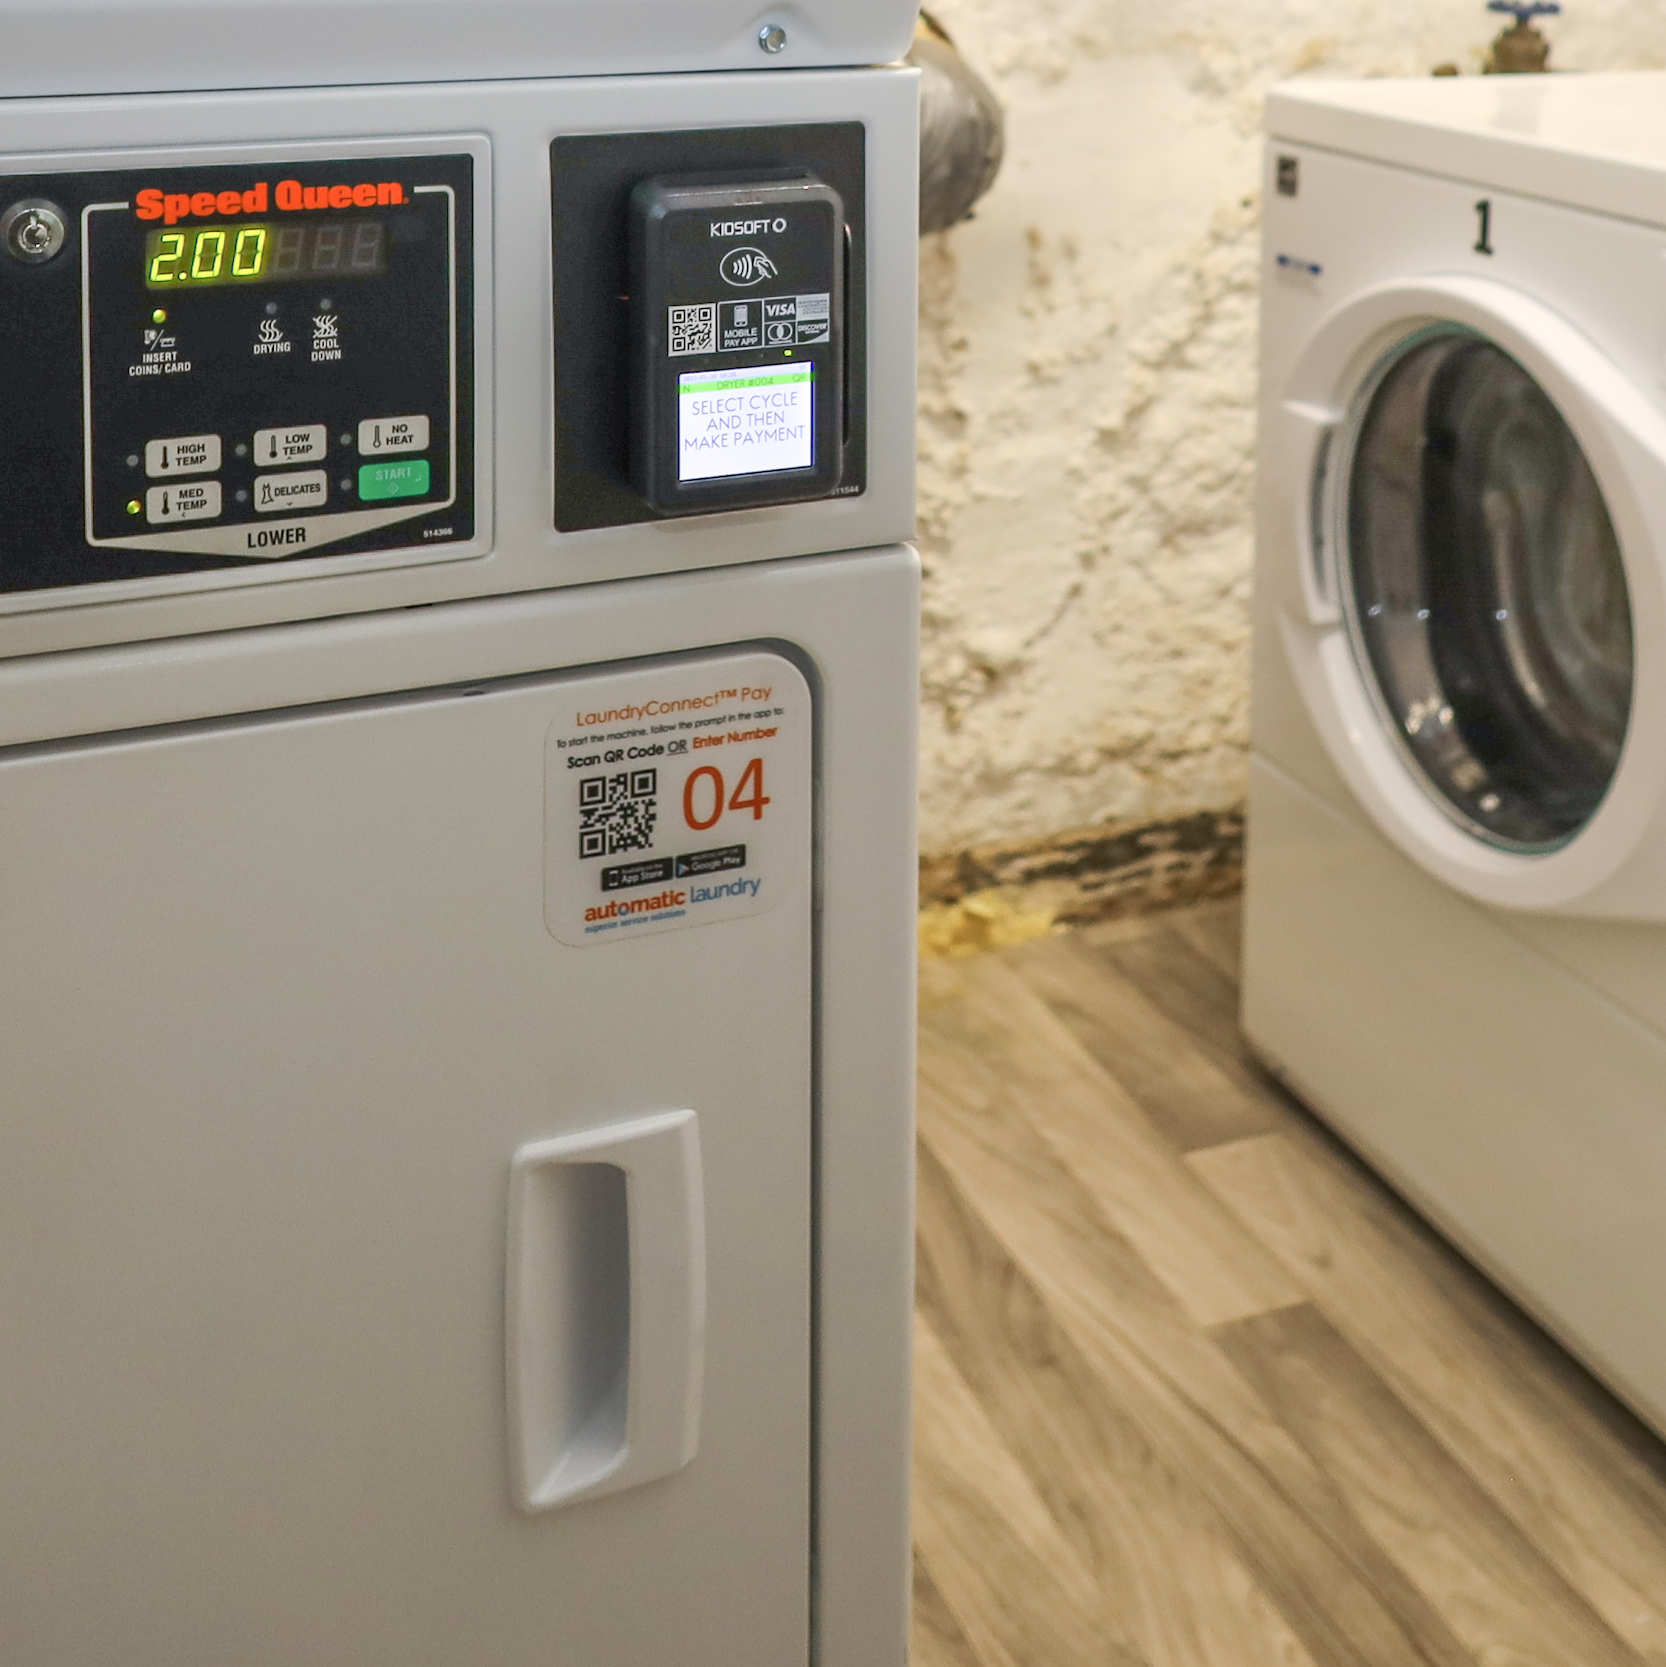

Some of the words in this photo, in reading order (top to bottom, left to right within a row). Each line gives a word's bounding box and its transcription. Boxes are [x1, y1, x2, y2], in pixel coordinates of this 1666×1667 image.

[136, 182, 268, 225] Speed
[710, 219, 771, 237] KIOSOFT
[1473, 200, 1493, 255] 1
[150, 229, 266, 282] 2.00
[765, 303, 796, 316] VISA
[724, 328, 757, 338] MOBILE
[313, 339, 339, 350] COOL
[741, 337, 757, 346] APP
[253, 342, 291, 355] DRYING
[142, 351, 178, 363] INSERT
[311, 350, 342, 362] DOWN
[165, 361, 191, 373] CARD
[717, 380, 745, 390] DRYER
[748, 377, 773, 387] #004
[792, 374, 806, 382] QR
[692, 397, 744, 416] SELECT
[749, 392, 798, 410] CYCLE
[706, 415, 741, 432] AND
[747, 411, 785, 427] THEN
[391, 424, 408, 434] NO
[285, 433, 310, 444] LOW
[385, 435, 414, 446] HEAT
[684, 433, 729, 451] MAKE
[734, 425, 805, 446] PAYMENT
[177, 443, 205, 454] HIGH
[282, 444, 313, 456] TEMP
[175, 454, 207, 466] TEMP
[375, 467, 411, 480] START
[179, 488, 204, 499] MED
[274, 483, 321, 497] DELICATES
[176, 499, 207, 511] TEMP
[247, 527, 306, 549] LOWER
[741, 686, 772, 702] Pay
[567, 753, 601, 769] Scan
[604, 749, 624, 764] QR
[627, 743, 664, 760] Code
[667, 739, 687, 755] OR
[692, 734, 725, 749] Enter
[727, 727, 778, 743] Number
[682, 757, 770, 831] 04
[585, 889, 686, 922] automatic
[690, 878, 761, 903] laundry
